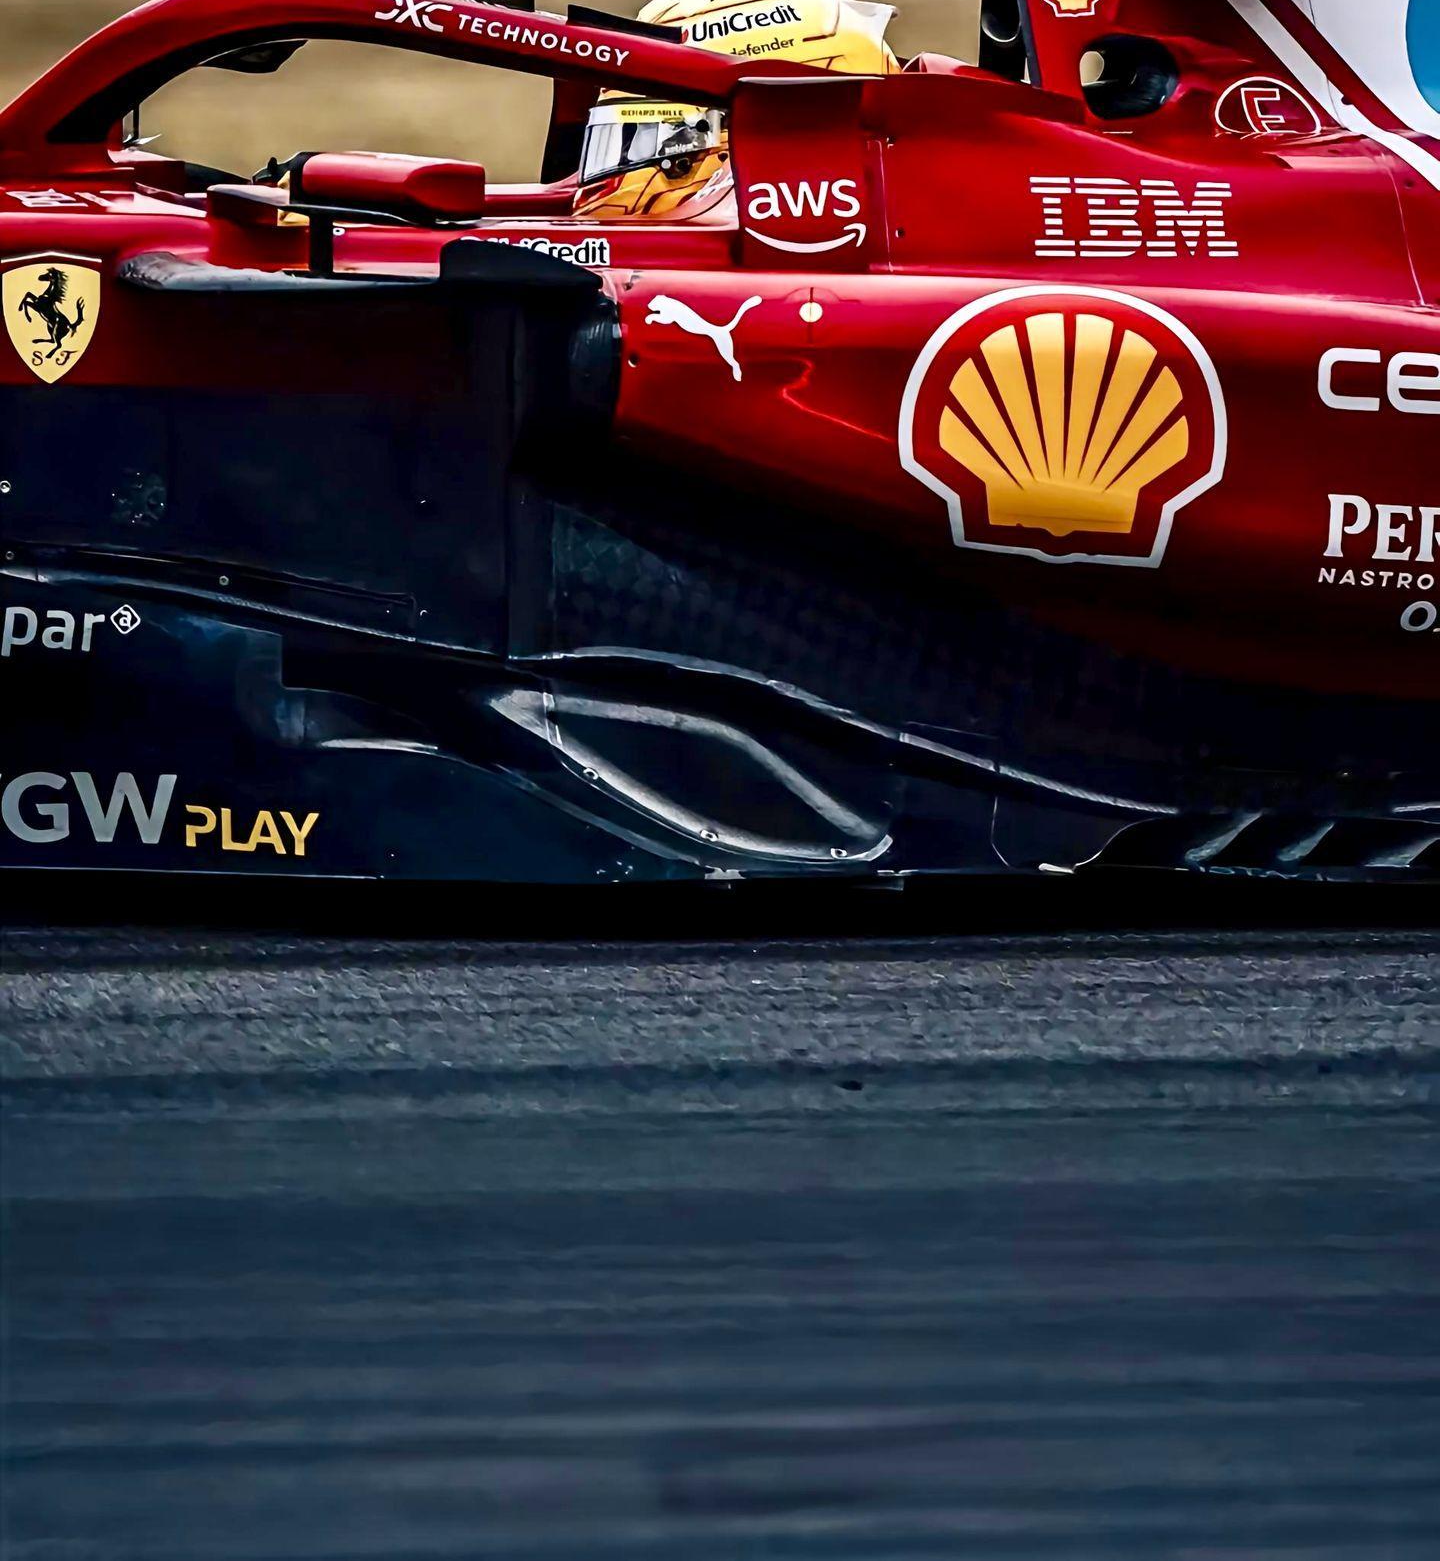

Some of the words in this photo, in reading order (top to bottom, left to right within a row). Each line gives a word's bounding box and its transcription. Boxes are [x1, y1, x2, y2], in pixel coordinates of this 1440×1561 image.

[458, 13, 630, 67] TECHNOLOGY
[692, 5, 802, 42] UniCredit
[747, 178, 861, 221] aws
[1030, 176, 1238, 258] IBM
[1317, 347, 1440, 415] ce
[1317, 567, 1435, 590] NASTRO
[1, 606, 106, 657] par
[0, 771, 178, 844] GW
[185, 804, 320, 856] PLAY
